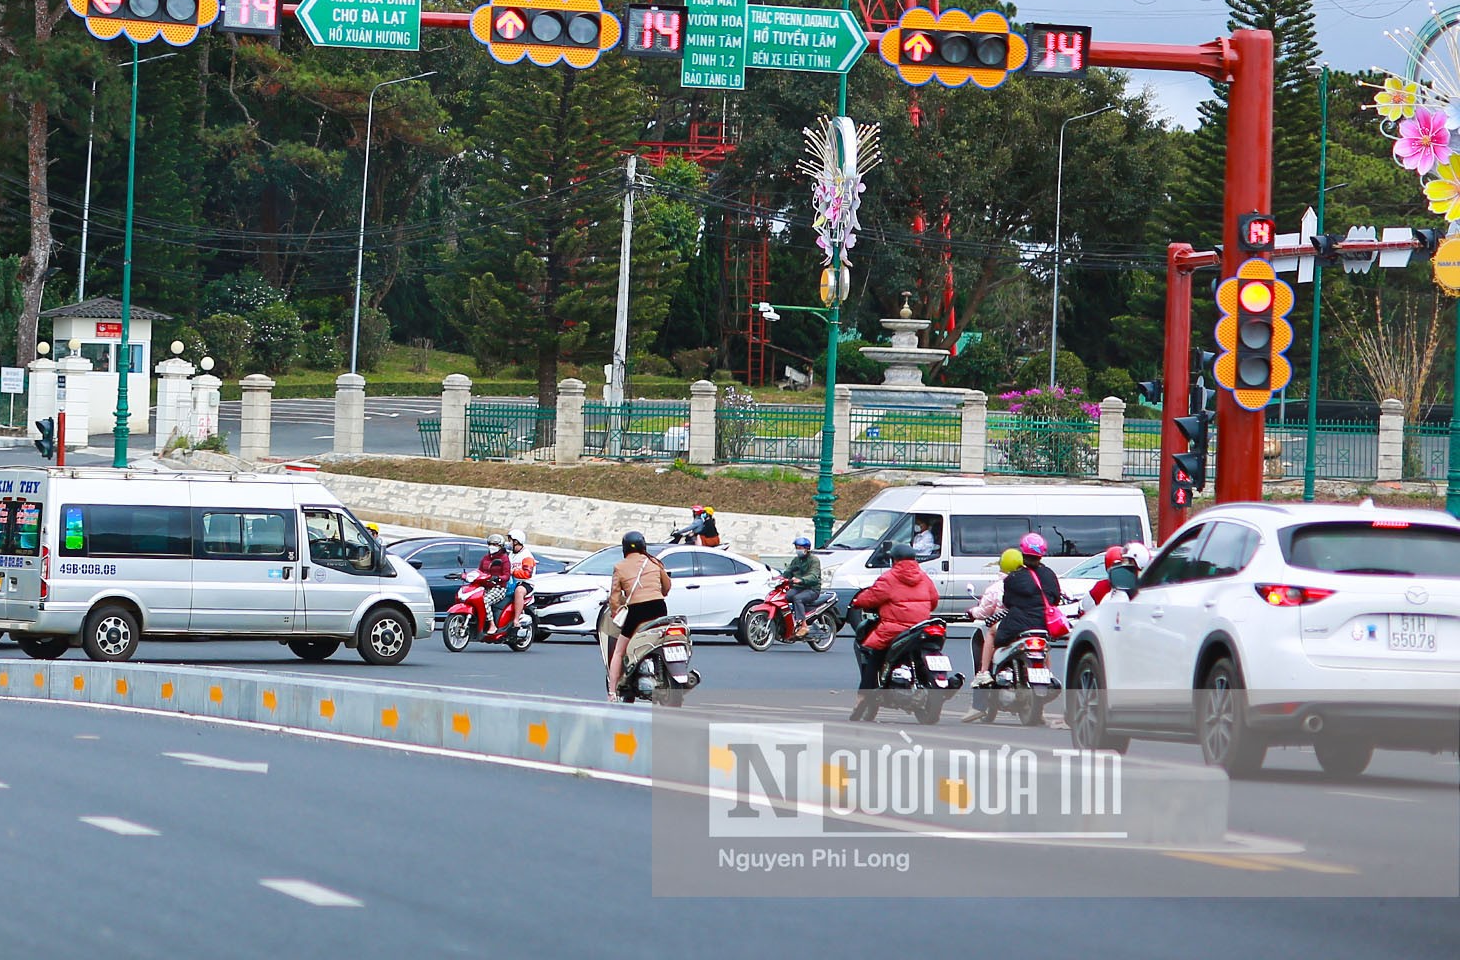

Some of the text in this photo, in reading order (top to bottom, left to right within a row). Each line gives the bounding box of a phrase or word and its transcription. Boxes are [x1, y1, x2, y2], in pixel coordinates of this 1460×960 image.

[332, 6, 407, 27] CHỢ ĐÀ LẠT
[687, 10, 744, 28] VƯỜN HOA
[751, 8, 773, 24] THÁC
[328, 24, 411, 46] HỒ XUÂN HƯƠNG
[643, 12, 680, 51] 14
[753, 25, 837, 48] HỒ TUYỀN LÂM
[686, 33, 742, 49] MINH TÂM
[691, 52, 717, 66] DINH
[752, 47, 770, 65] BẾN
[771, 52, 782, 66] XE
[784, 50, 805, 67] LIÊN
[1045, 31, 1083, 71] 14
[684, 68, 741, 87] BẢO TÀNG LĐ
[19, 481, 40, 494] THY
[1401, 616, 1426, 632] 51H
[1392, 632, 1436, 649] 550.78
